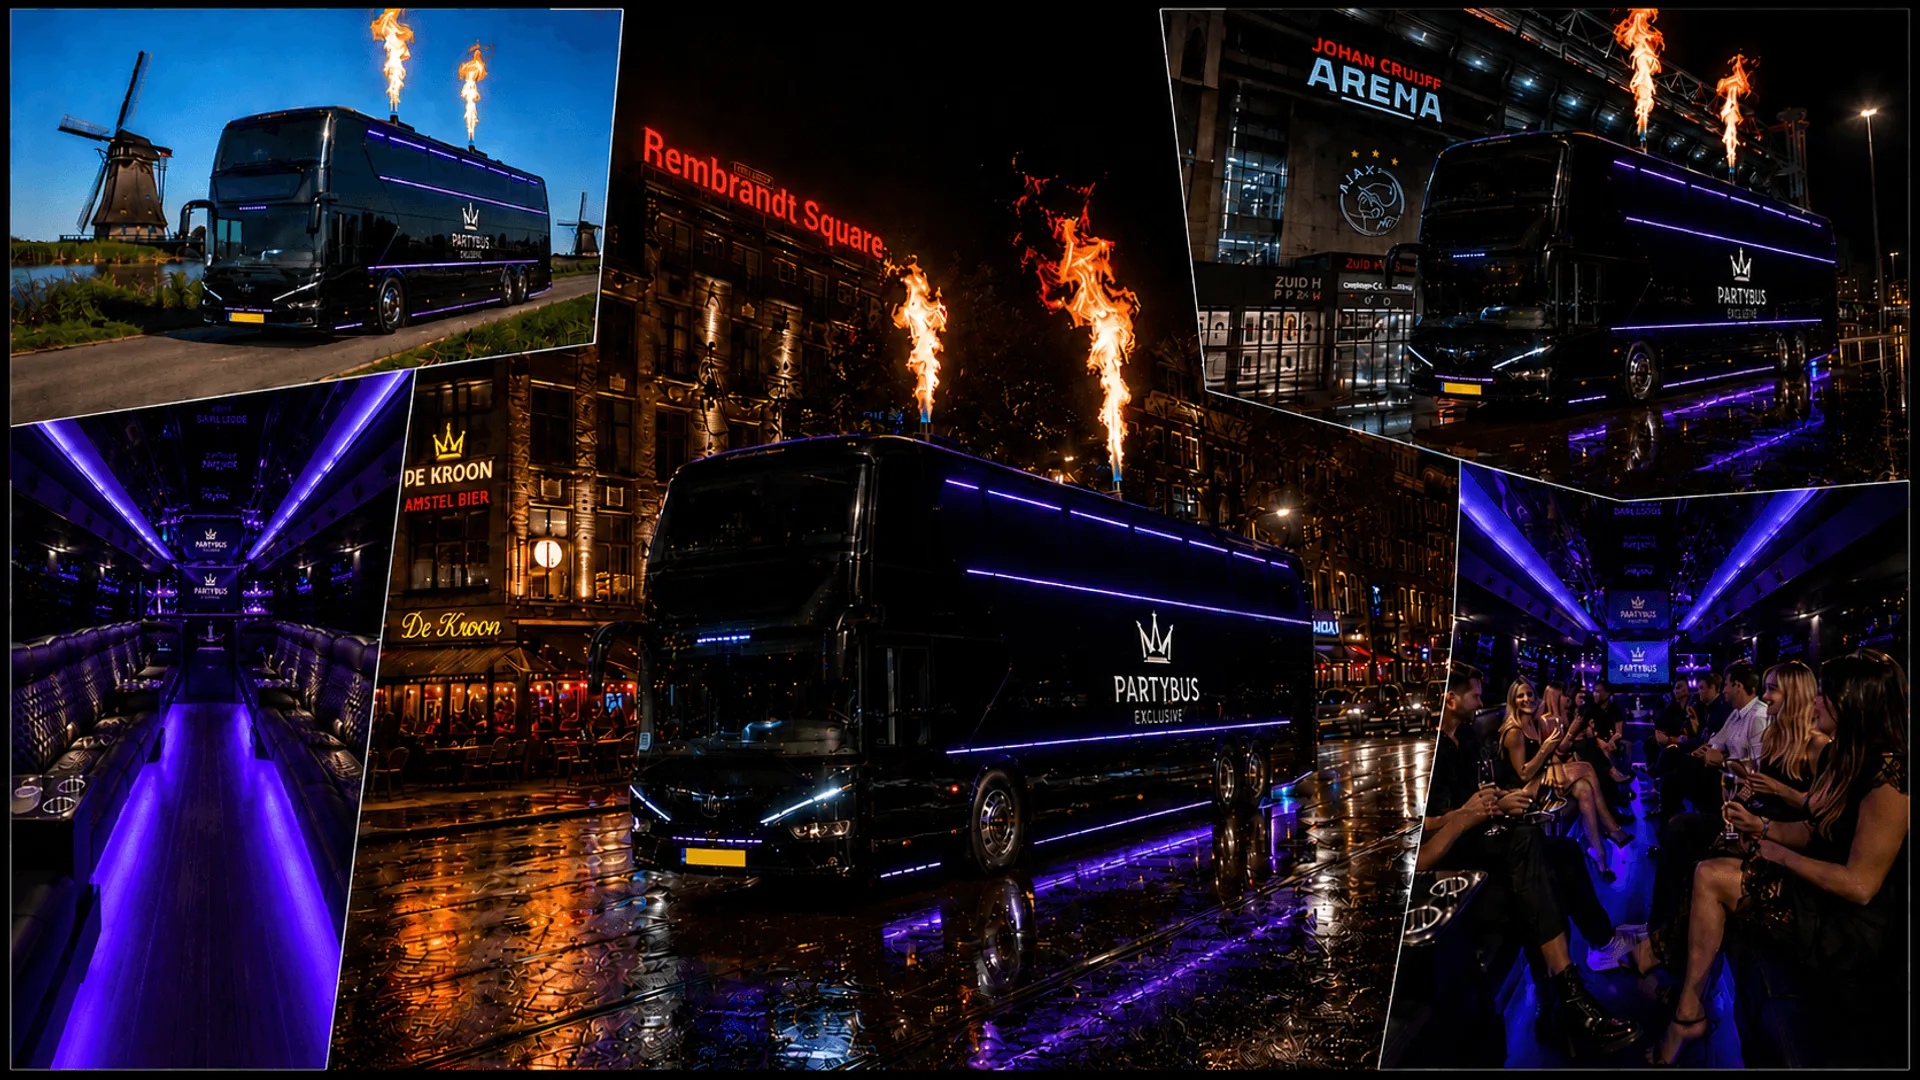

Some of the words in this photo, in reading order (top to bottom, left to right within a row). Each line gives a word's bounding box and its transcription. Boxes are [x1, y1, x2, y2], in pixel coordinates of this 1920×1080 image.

[1312, 37, 1375, 69] JOHAN
[1380, 58, 1442, 90] CRUIJFF
[643, 126, 798, 225] Rembrandt
[803, 200, 884, 259] Square
[1340, 165, 1375, 195] AJAX
[1274, 275, 1309, 289] ZUID
[1311, 276, 1322, 290] H
[1717, 285, 1767, 305] PARTYBUS
[404, 468, 426, 488] DE
[430, 460, 493, 485] KROON
[404, 493, 455, 513] AMSTEL
[457, 489, 490, 507] BIER
[401, 611, 432, 639] De
[436, 612, 502, 638] Kroon
[1113, 675, 1201, 703] PARTYBUS
[1134, 708, 1183, 725] EXCLUSIVE
